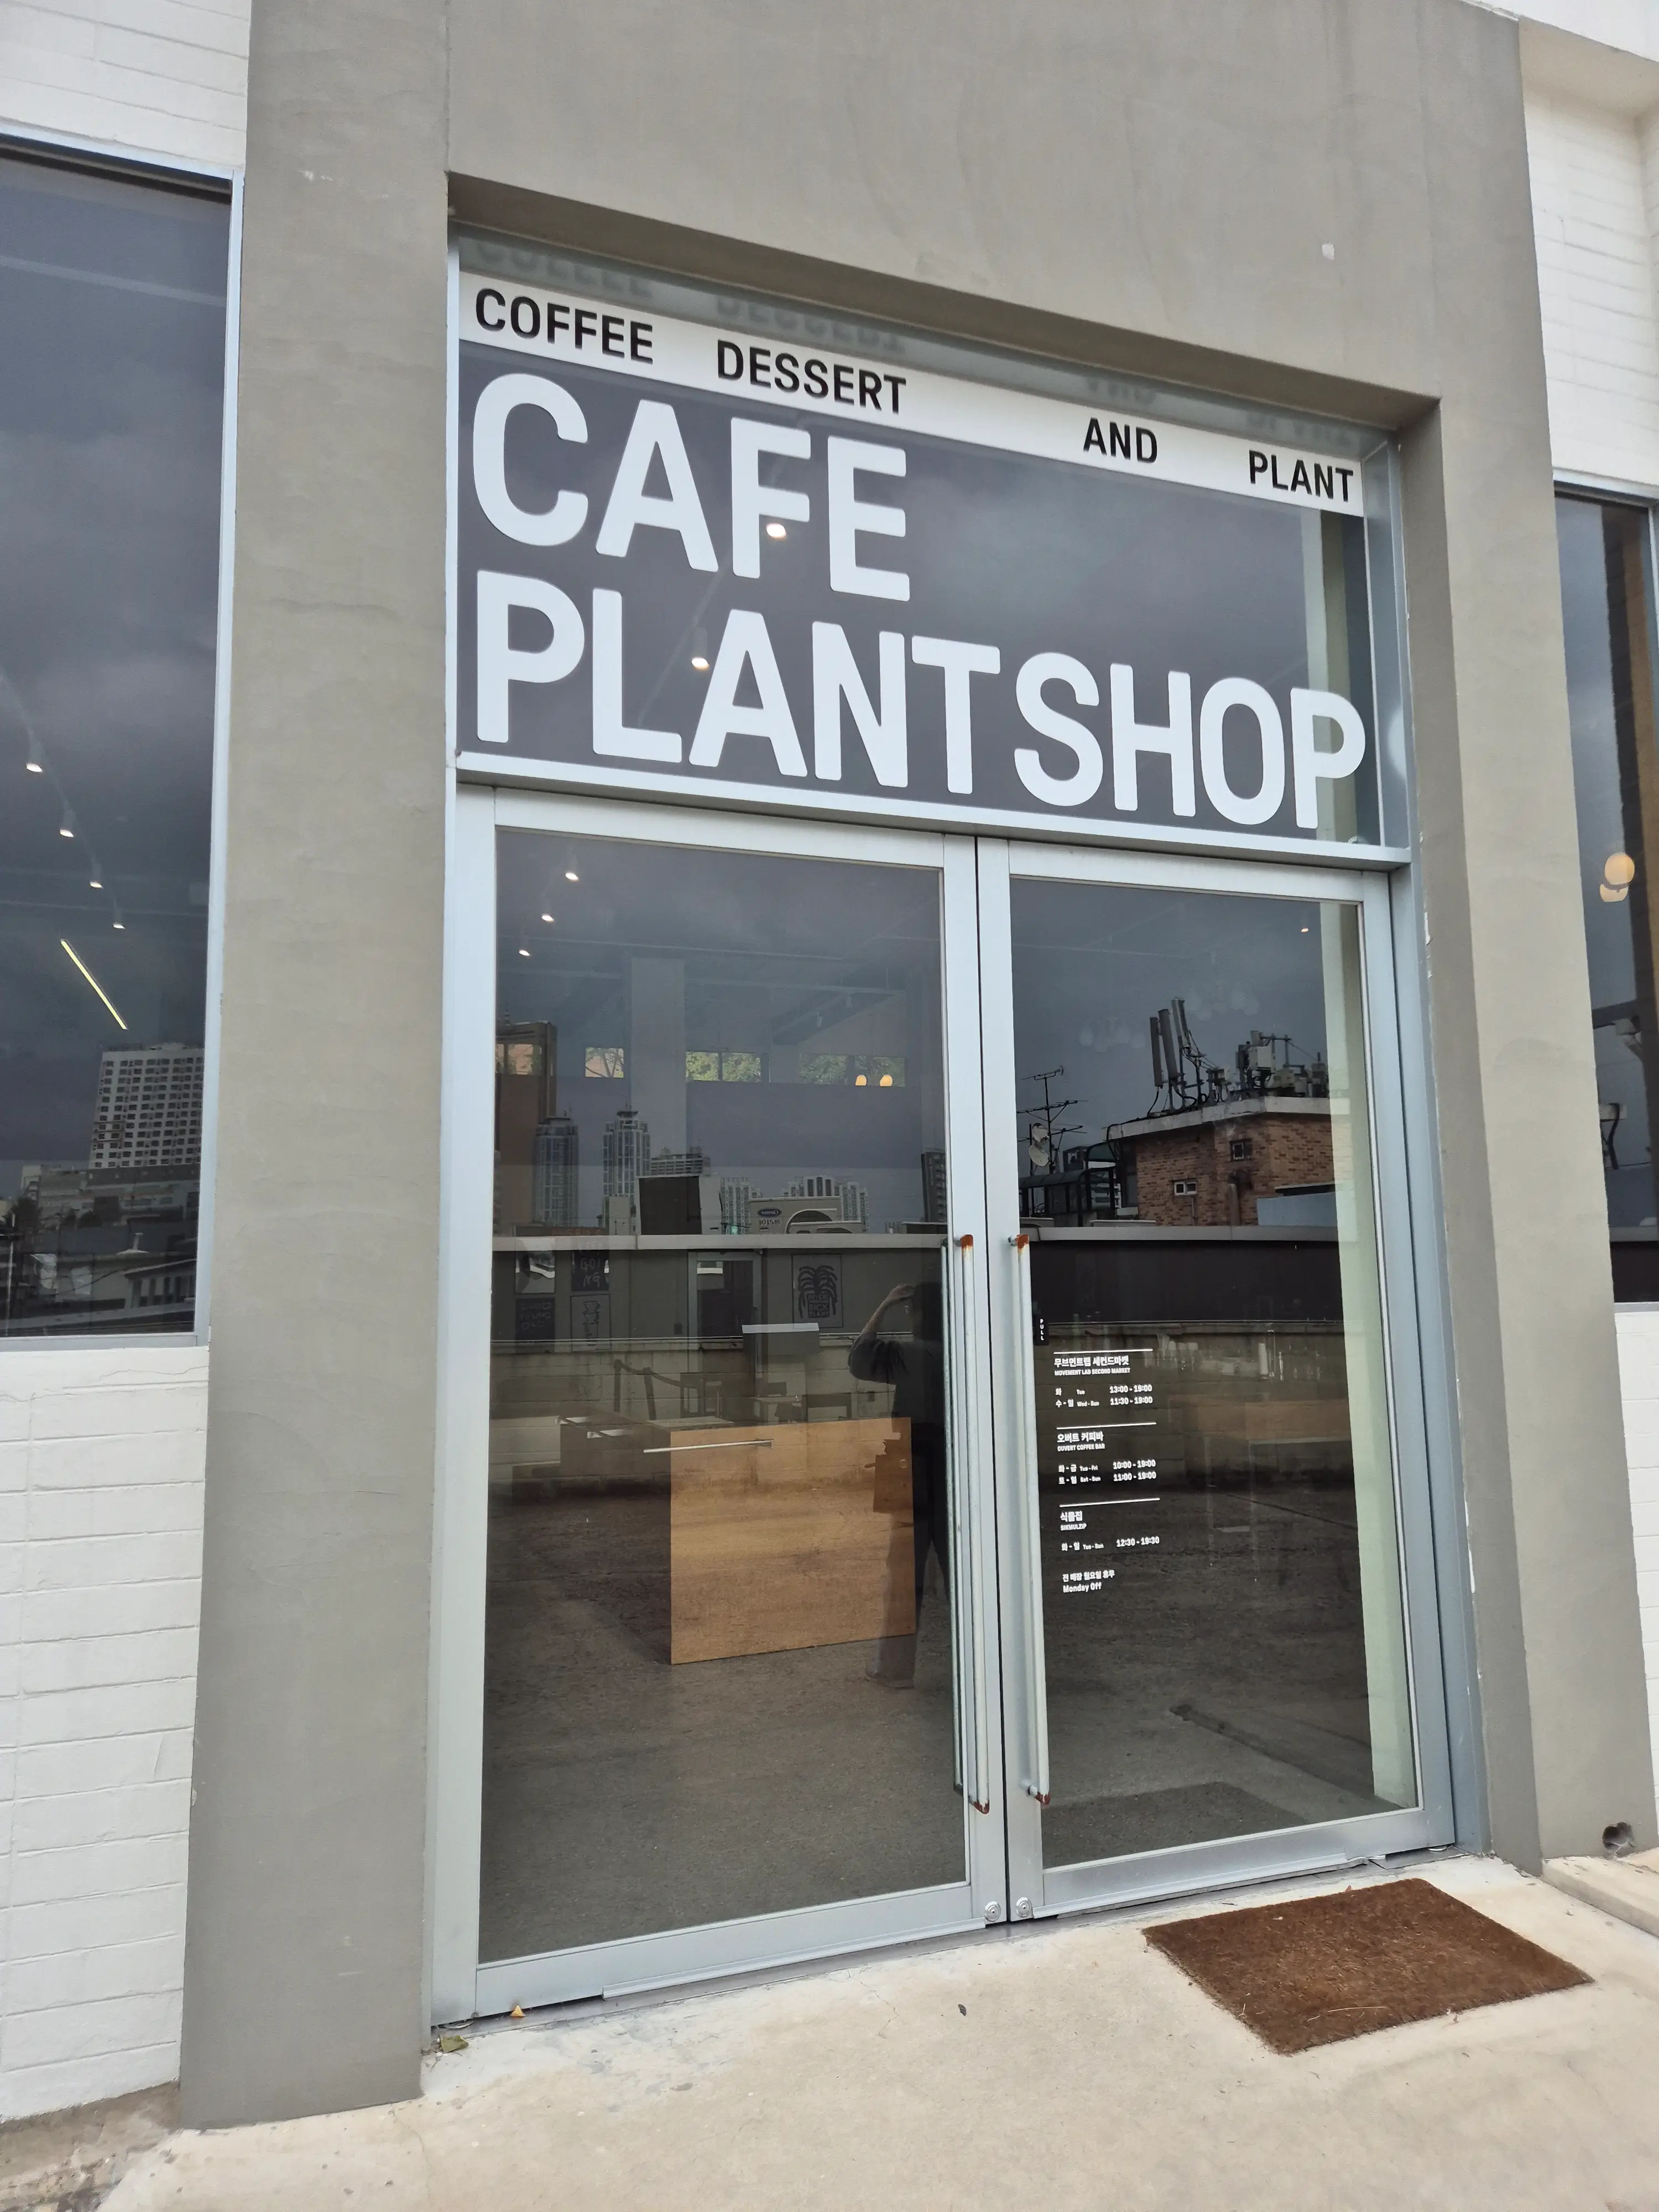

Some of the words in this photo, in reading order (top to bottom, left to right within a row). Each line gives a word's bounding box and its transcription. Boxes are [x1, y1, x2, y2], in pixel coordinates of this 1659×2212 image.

[476, 287, 654, 364] COFFEE
[717, 338, 907, 414] DESSERT
[1083, 417, 1157, 463] AND
[1249, 450, 1353, 502] PLANT
[473, 373, 910, 602] CAFE
[1054, 1357, 1091, 1368] 무브먼트랩
[1093, 1355, 1129, 1366] 세컨드마켓
[1055, 1387, 1062, 1396] 화
[1109, 1385, 1128, 1394] 13:00
[1068, 1399, 1074, 1407] 일
[1110, 1397, 1129, 1406] 11:30
[1057, 1432, 1079, 1443] 오버트
[1081, 1431, 1104, 1442] 커피바
[1058, 1464, 1065, 1473] 화
[1070, 1464, 1077, 1473] 금
[1113, 1461, 1131, 1469] 10:00
[1071, 1476, 1077, 1484] 일
[1113, 1473, 1132, 1481] 11:00
[1060, 1510, 1083, 1522] 식물집
[1061, 1543, 1068, 1551] 화
[1073, 1542, 1080, 1551] 일
[1116, 1538, 1135, 1547] 12:30
[1062, 1574, 1069, 1582] 전
[1070, 1572, 1082, 1581] 매장
[1084, 1571, 1102, 1580] 월요일
[1103, 1569, 1115, 1578] 휴무
[1063, 1584, 1089, 1593] Monday
[1091, 1582, 1102, 1590] Off
